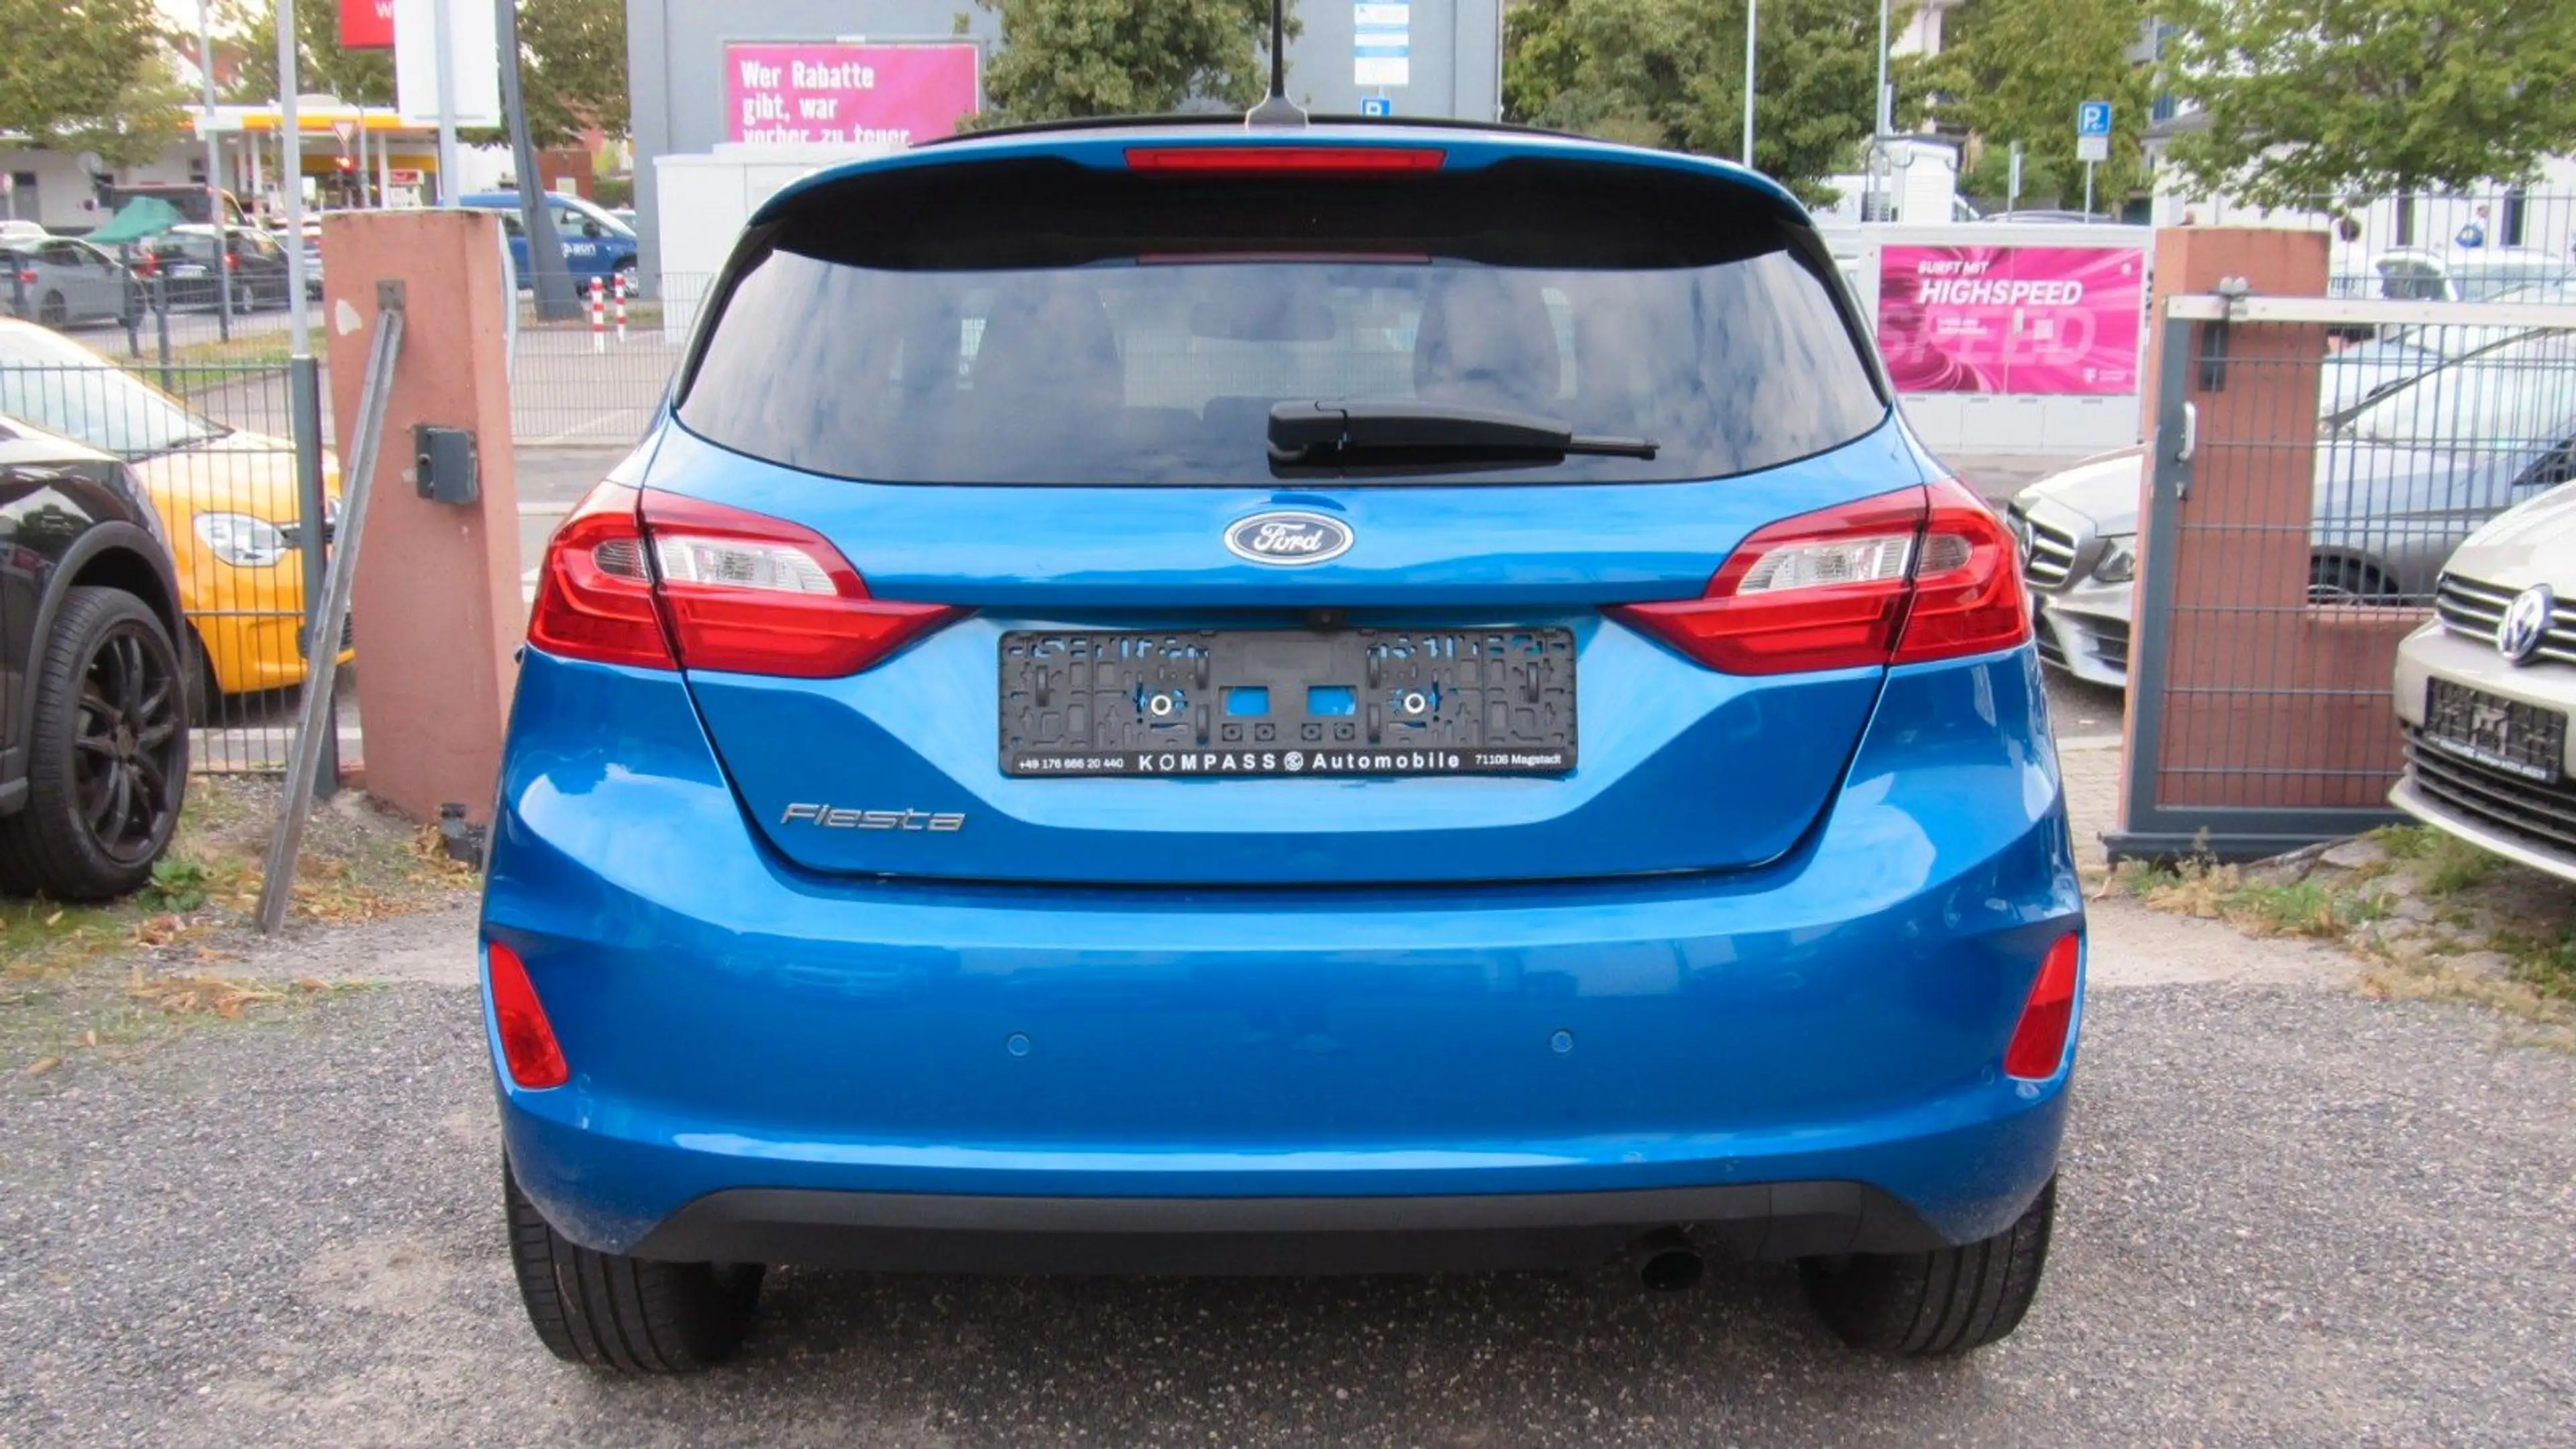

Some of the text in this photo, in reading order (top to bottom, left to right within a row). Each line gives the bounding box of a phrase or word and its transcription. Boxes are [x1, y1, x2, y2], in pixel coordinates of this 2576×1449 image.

[741, 61, 874, 89] Wer Rabatte
[743, 93, 837, 125] gibt, war
[1918, 279, 2083, 305] HIGHSPEED
[1253, 523, 1324, 551] Ford
[1042, 758, 1061, 769] 176
[1087, 758, 1100, 769] 20
[1138, 752, 1460, 771] KOMPASS Automobile
[1475, 754, 1562, 767] 71106 Magstadt
[780, 803, 965, 831] Fiesta
